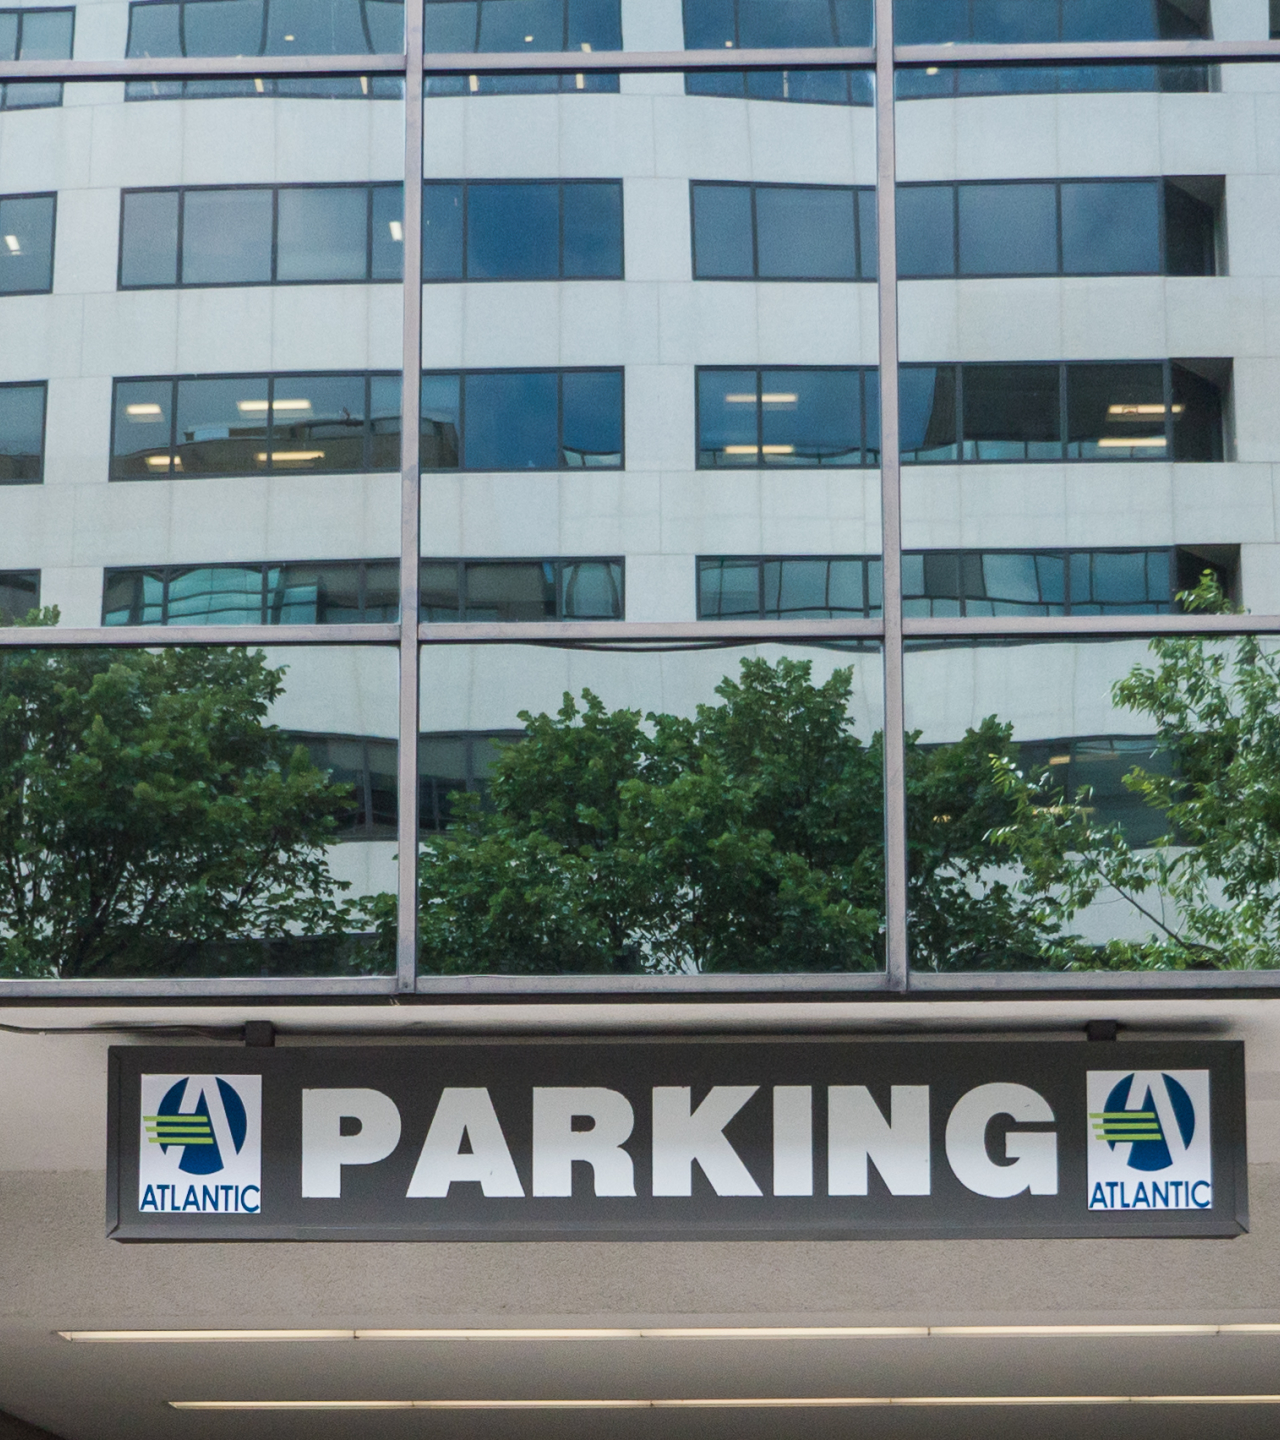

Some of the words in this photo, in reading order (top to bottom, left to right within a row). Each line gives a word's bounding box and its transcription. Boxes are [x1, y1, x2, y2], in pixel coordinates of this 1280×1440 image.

[301, 1082, 1059, 1198] PARKING
[139, 1184, 260, 1213] ATLANTIC
[1089, 1179, 1212, 1210] ATLANTIC
